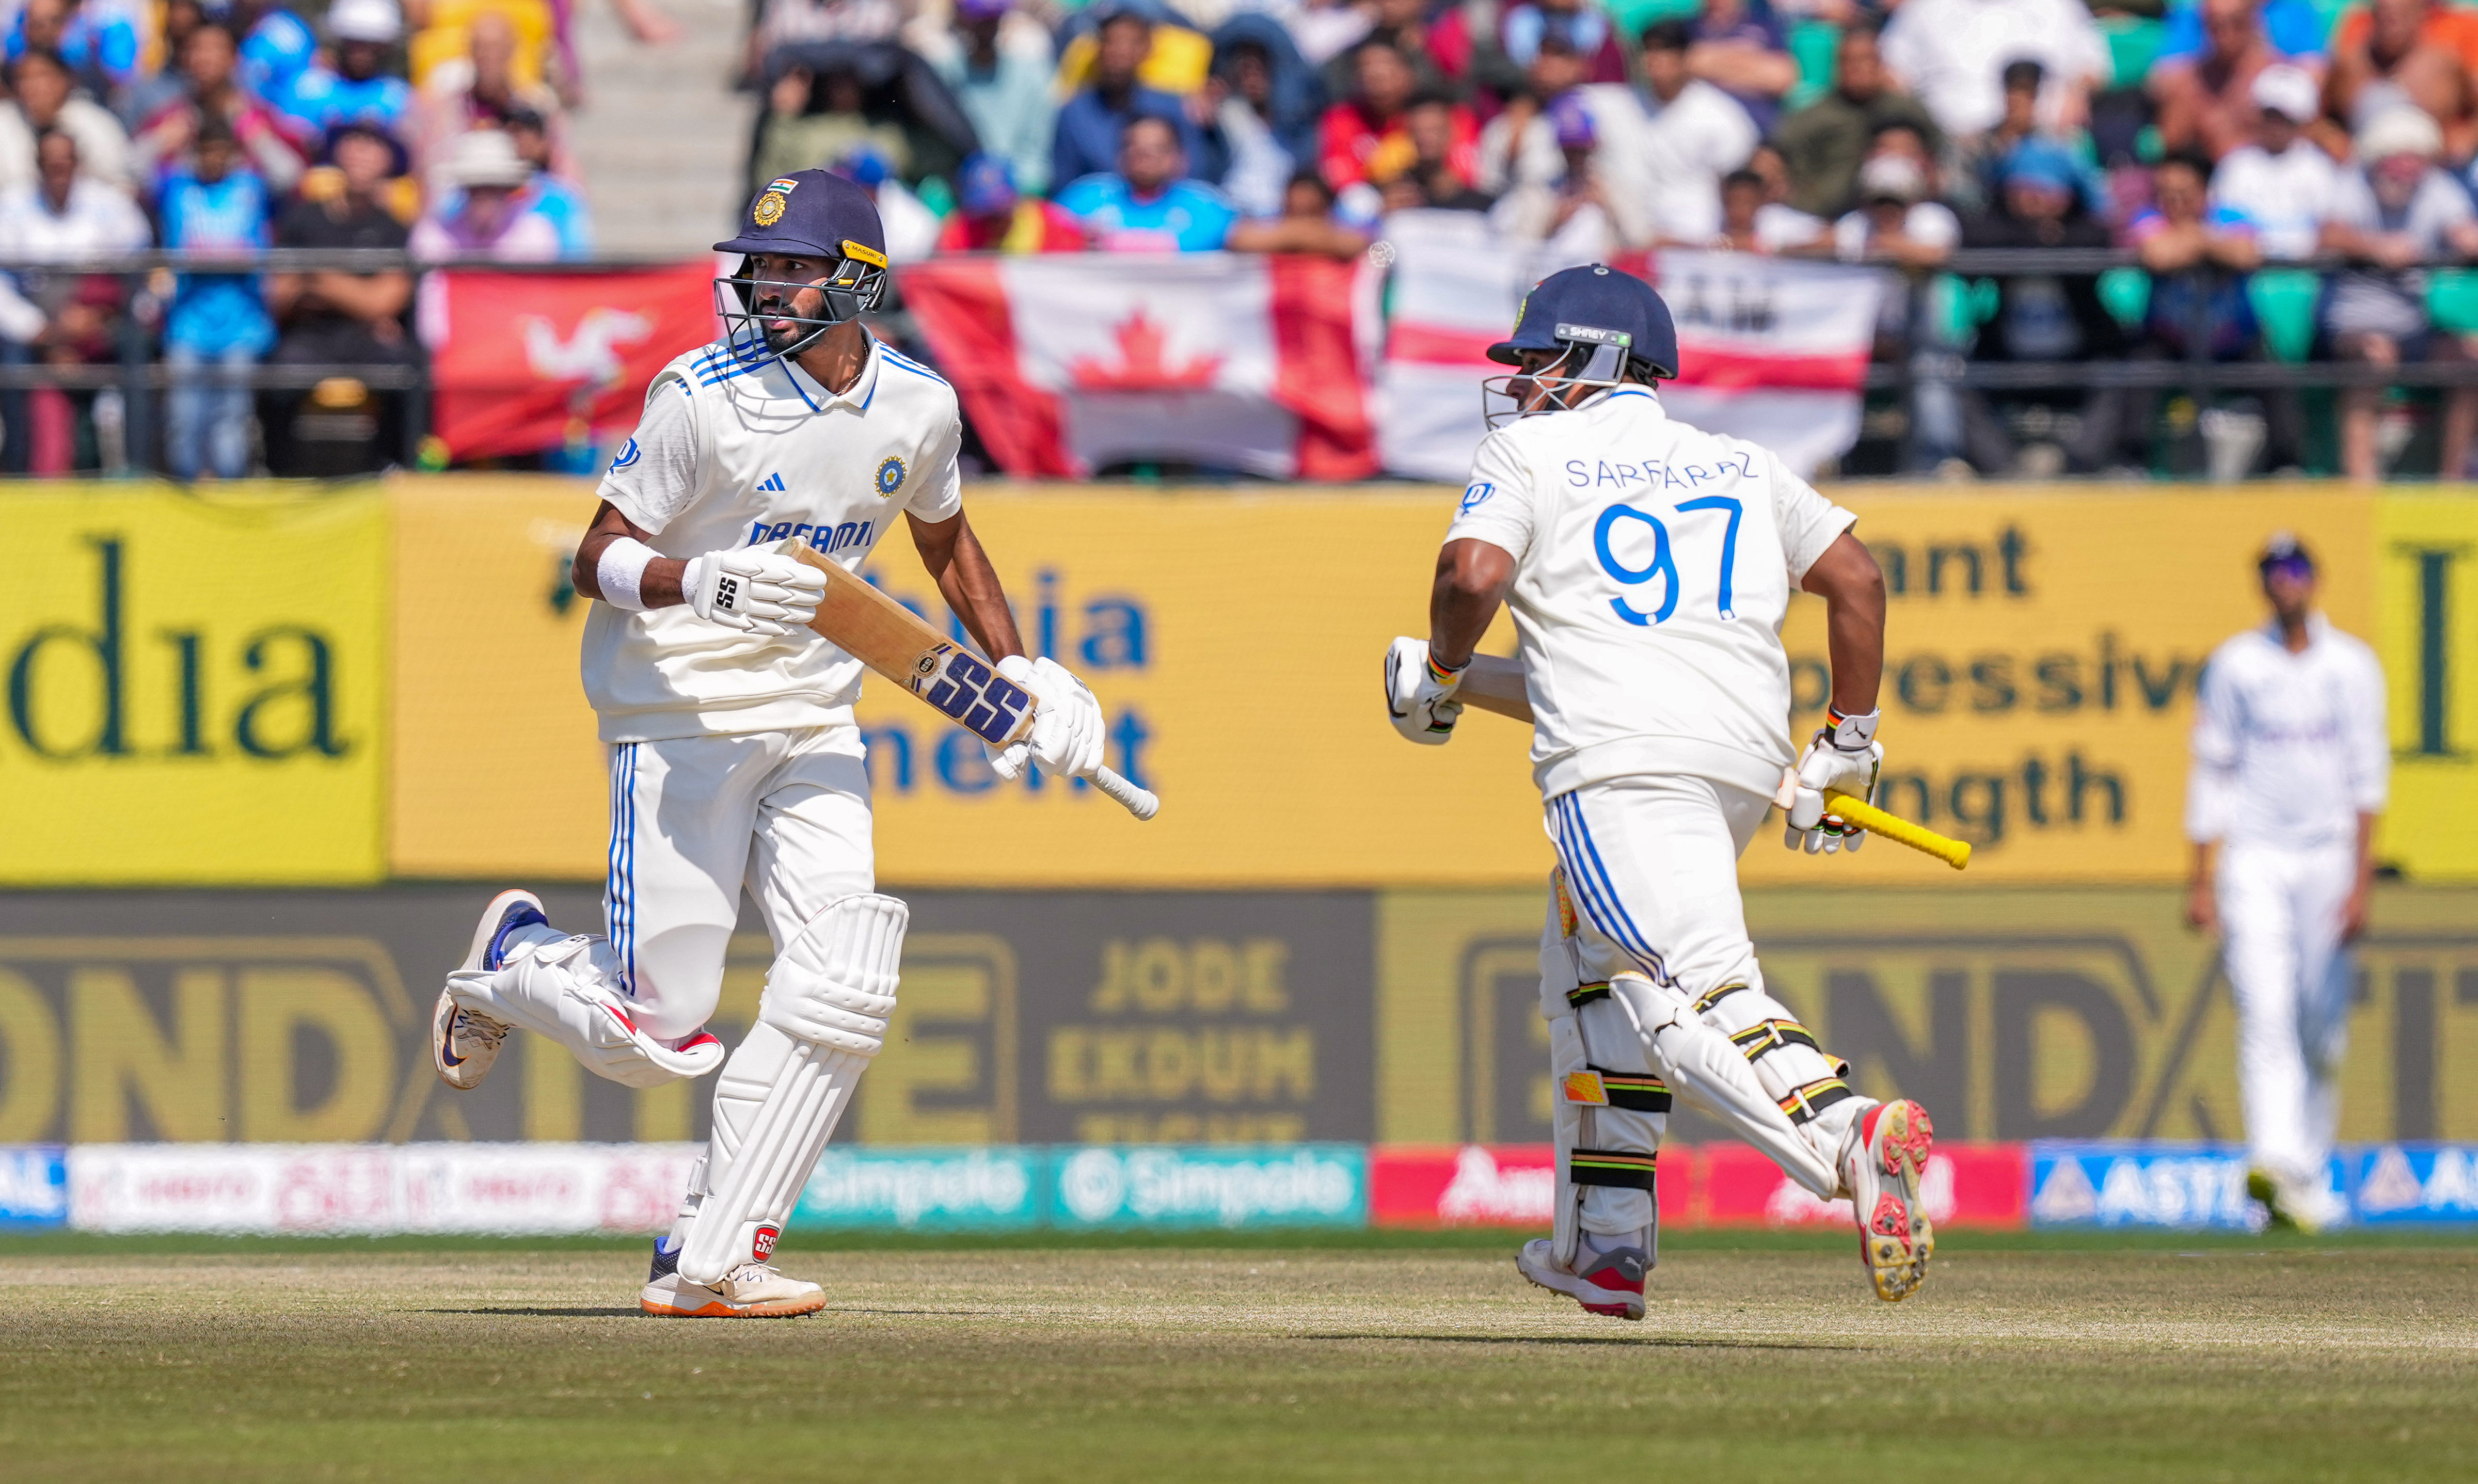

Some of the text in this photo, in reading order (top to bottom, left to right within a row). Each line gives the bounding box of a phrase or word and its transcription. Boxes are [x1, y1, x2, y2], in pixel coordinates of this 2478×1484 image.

[852, 245, 877, 259] MASURI
[1569, 327, 1607, 340] SHREY
[1594, 495, 1743, 627] 97
[716, 577, 738, 609] SS
[926, 652, 1029, 743] SS
[755, 1233, 777, 1255] SS
